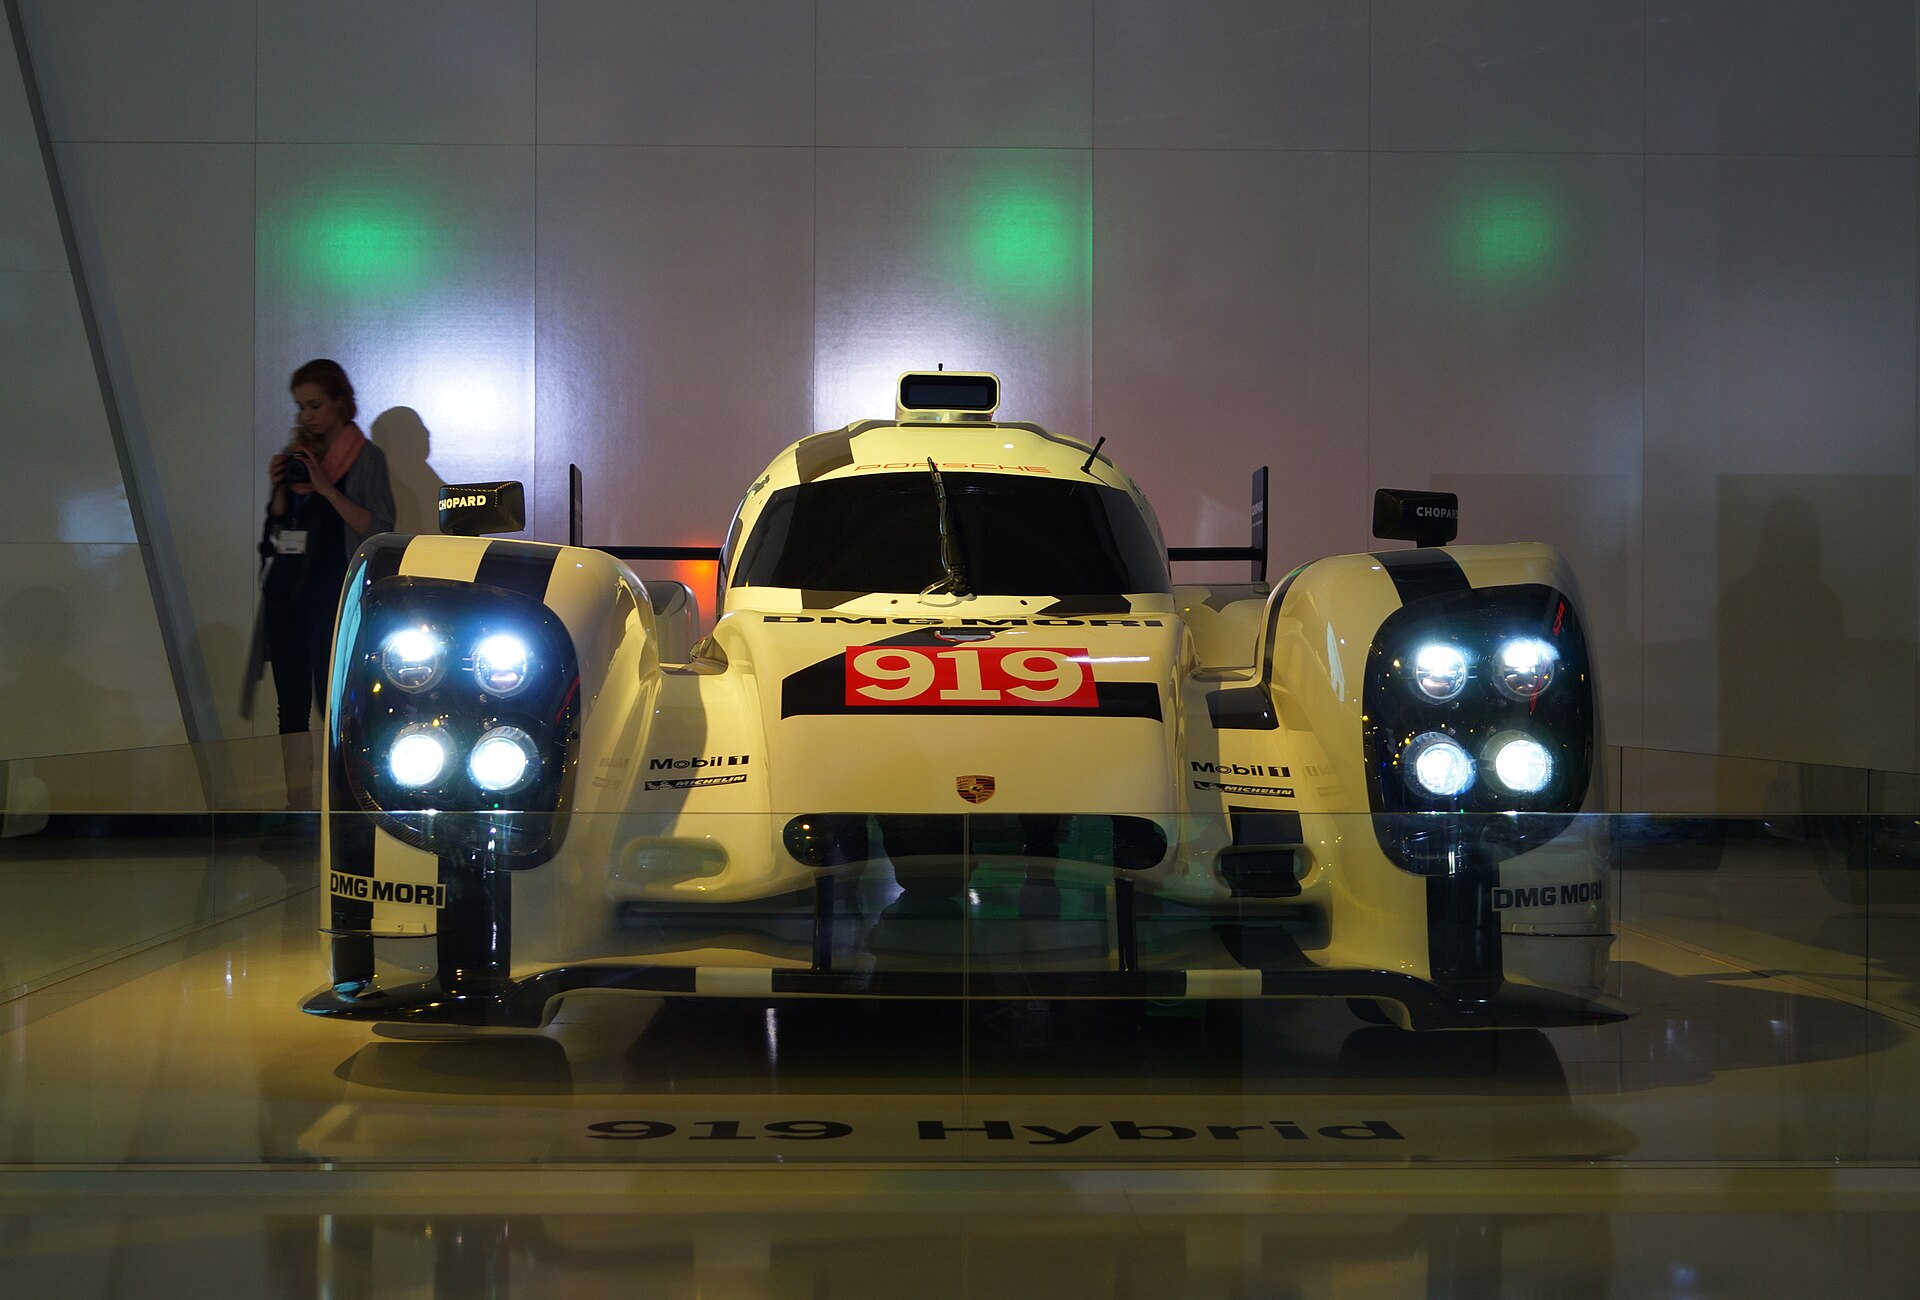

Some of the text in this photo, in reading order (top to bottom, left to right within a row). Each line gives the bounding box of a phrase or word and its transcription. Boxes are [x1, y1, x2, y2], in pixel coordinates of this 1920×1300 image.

[854, 462, 1052, 473] PORSCHE
[438, 495, 487, 511] CHOPARD
[763, 616, 1163, 627] DMG MORI
[853, 649, 1083, 702] 919
[650, 756, 722, 770] Mobil
[1191, 761, 1264, 776] Mobil
[674, 775, 746, 787] MICHELIN
[1223, 785, 1293, 796] MICHELIN
[331, 872, 444, 906] DMG MORI
[1493, 880, 1602, 909] DMG MORI
[586, 1120, 1405, 1145] 919 Hybrid
